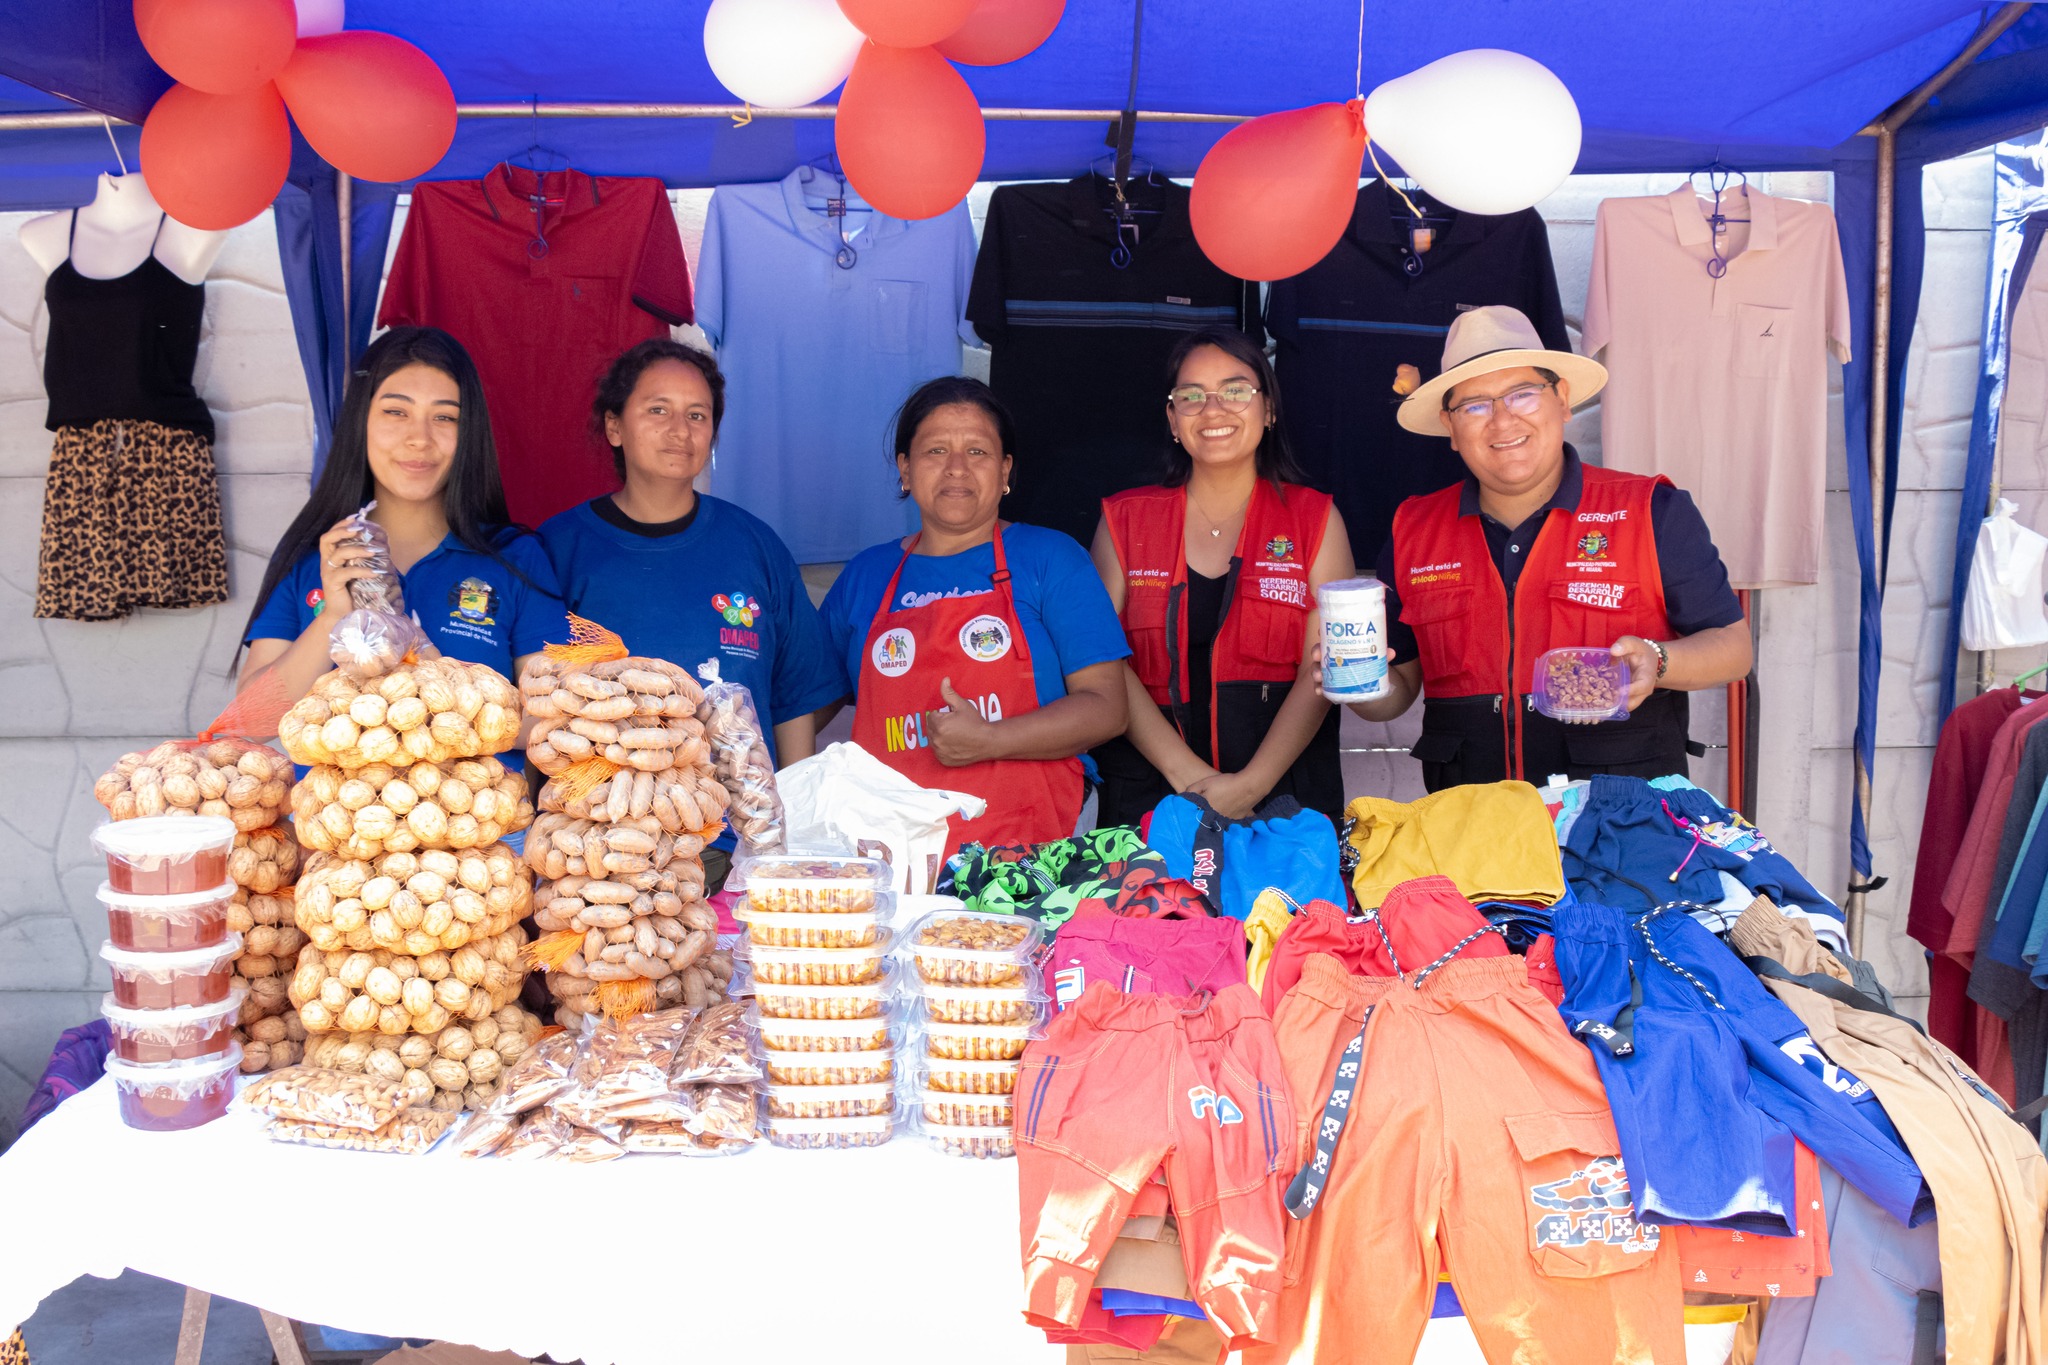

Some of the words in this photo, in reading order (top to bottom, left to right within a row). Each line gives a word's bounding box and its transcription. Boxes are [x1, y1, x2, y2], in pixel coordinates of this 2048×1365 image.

[1577, 510, 1628, 523] GERENTE
[1411, 564, 1434, 574] Huaral
[1259, 577, 1299, 587] GERENCIA
[1568, 587, 1623, 599] DESARROLLO
[1613, 584, 1625, 593] DE
[1260, 588, 1306, 608] SOCIAL
[1567, 593, 1622, 609] SOCIAL
[1325, 620, 1377, 637] FORZA
[720, 627, 760, 650] OMAPED
[880, 660, 908, 669] OMAPED
